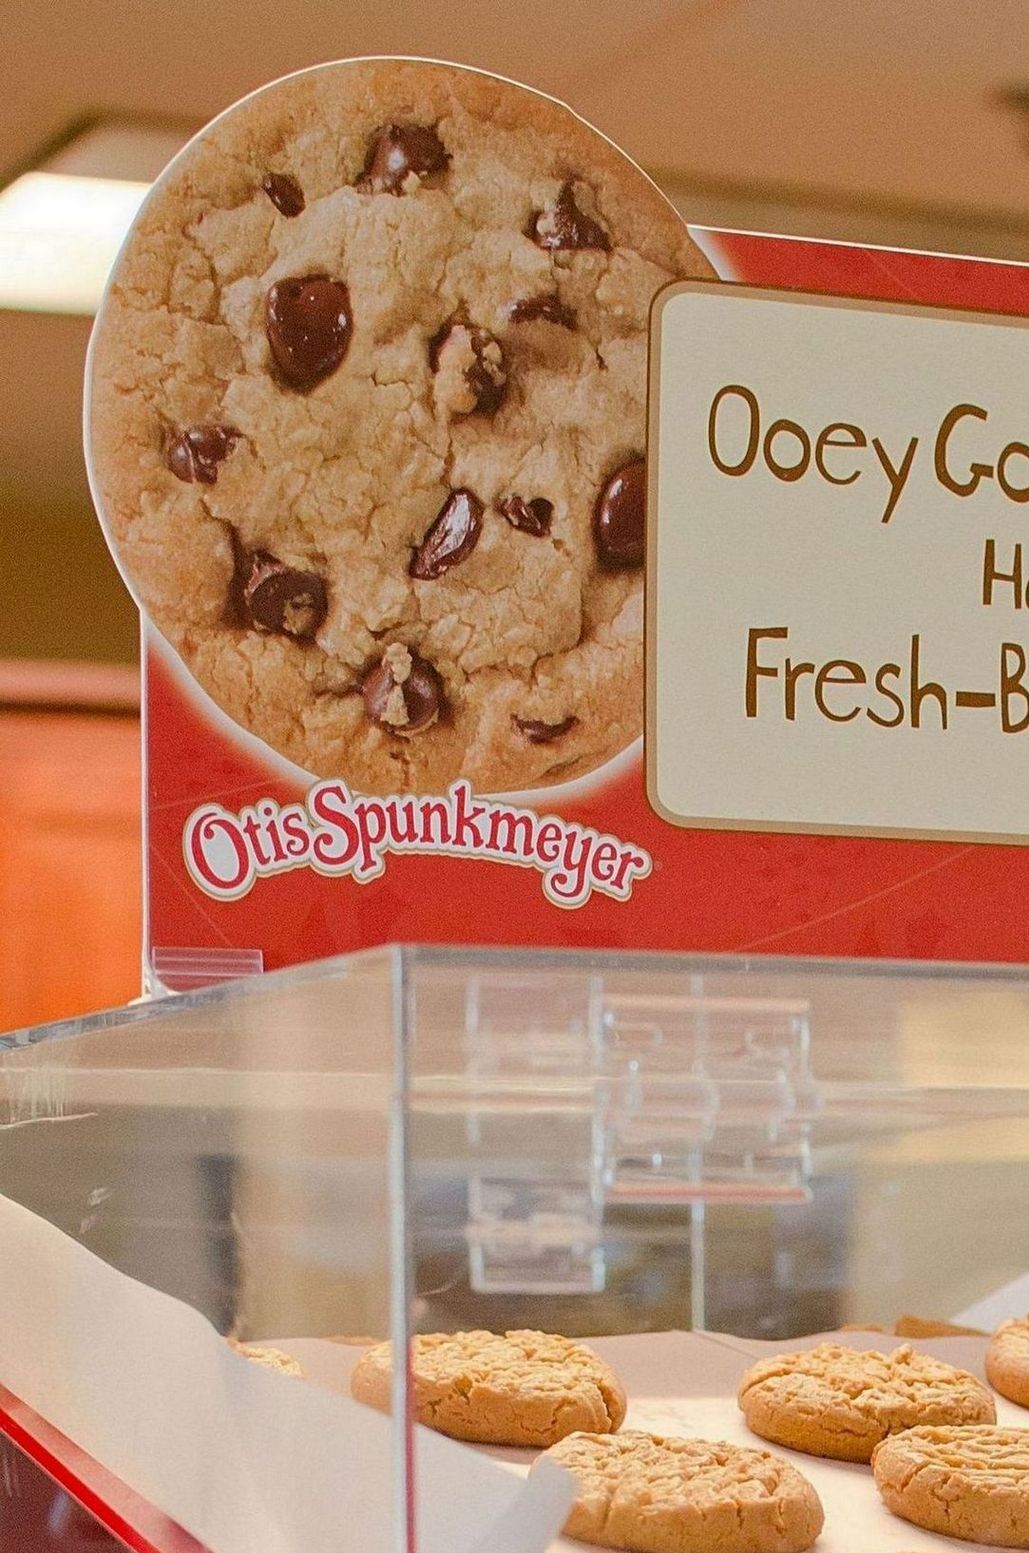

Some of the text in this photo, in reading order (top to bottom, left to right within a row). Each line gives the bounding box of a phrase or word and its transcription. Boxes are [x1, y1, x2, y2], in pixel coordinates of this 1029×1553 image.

[708, 385, 918, 523] Ooey
[191, 785, 645, 898] Otis Spunkmeyer
